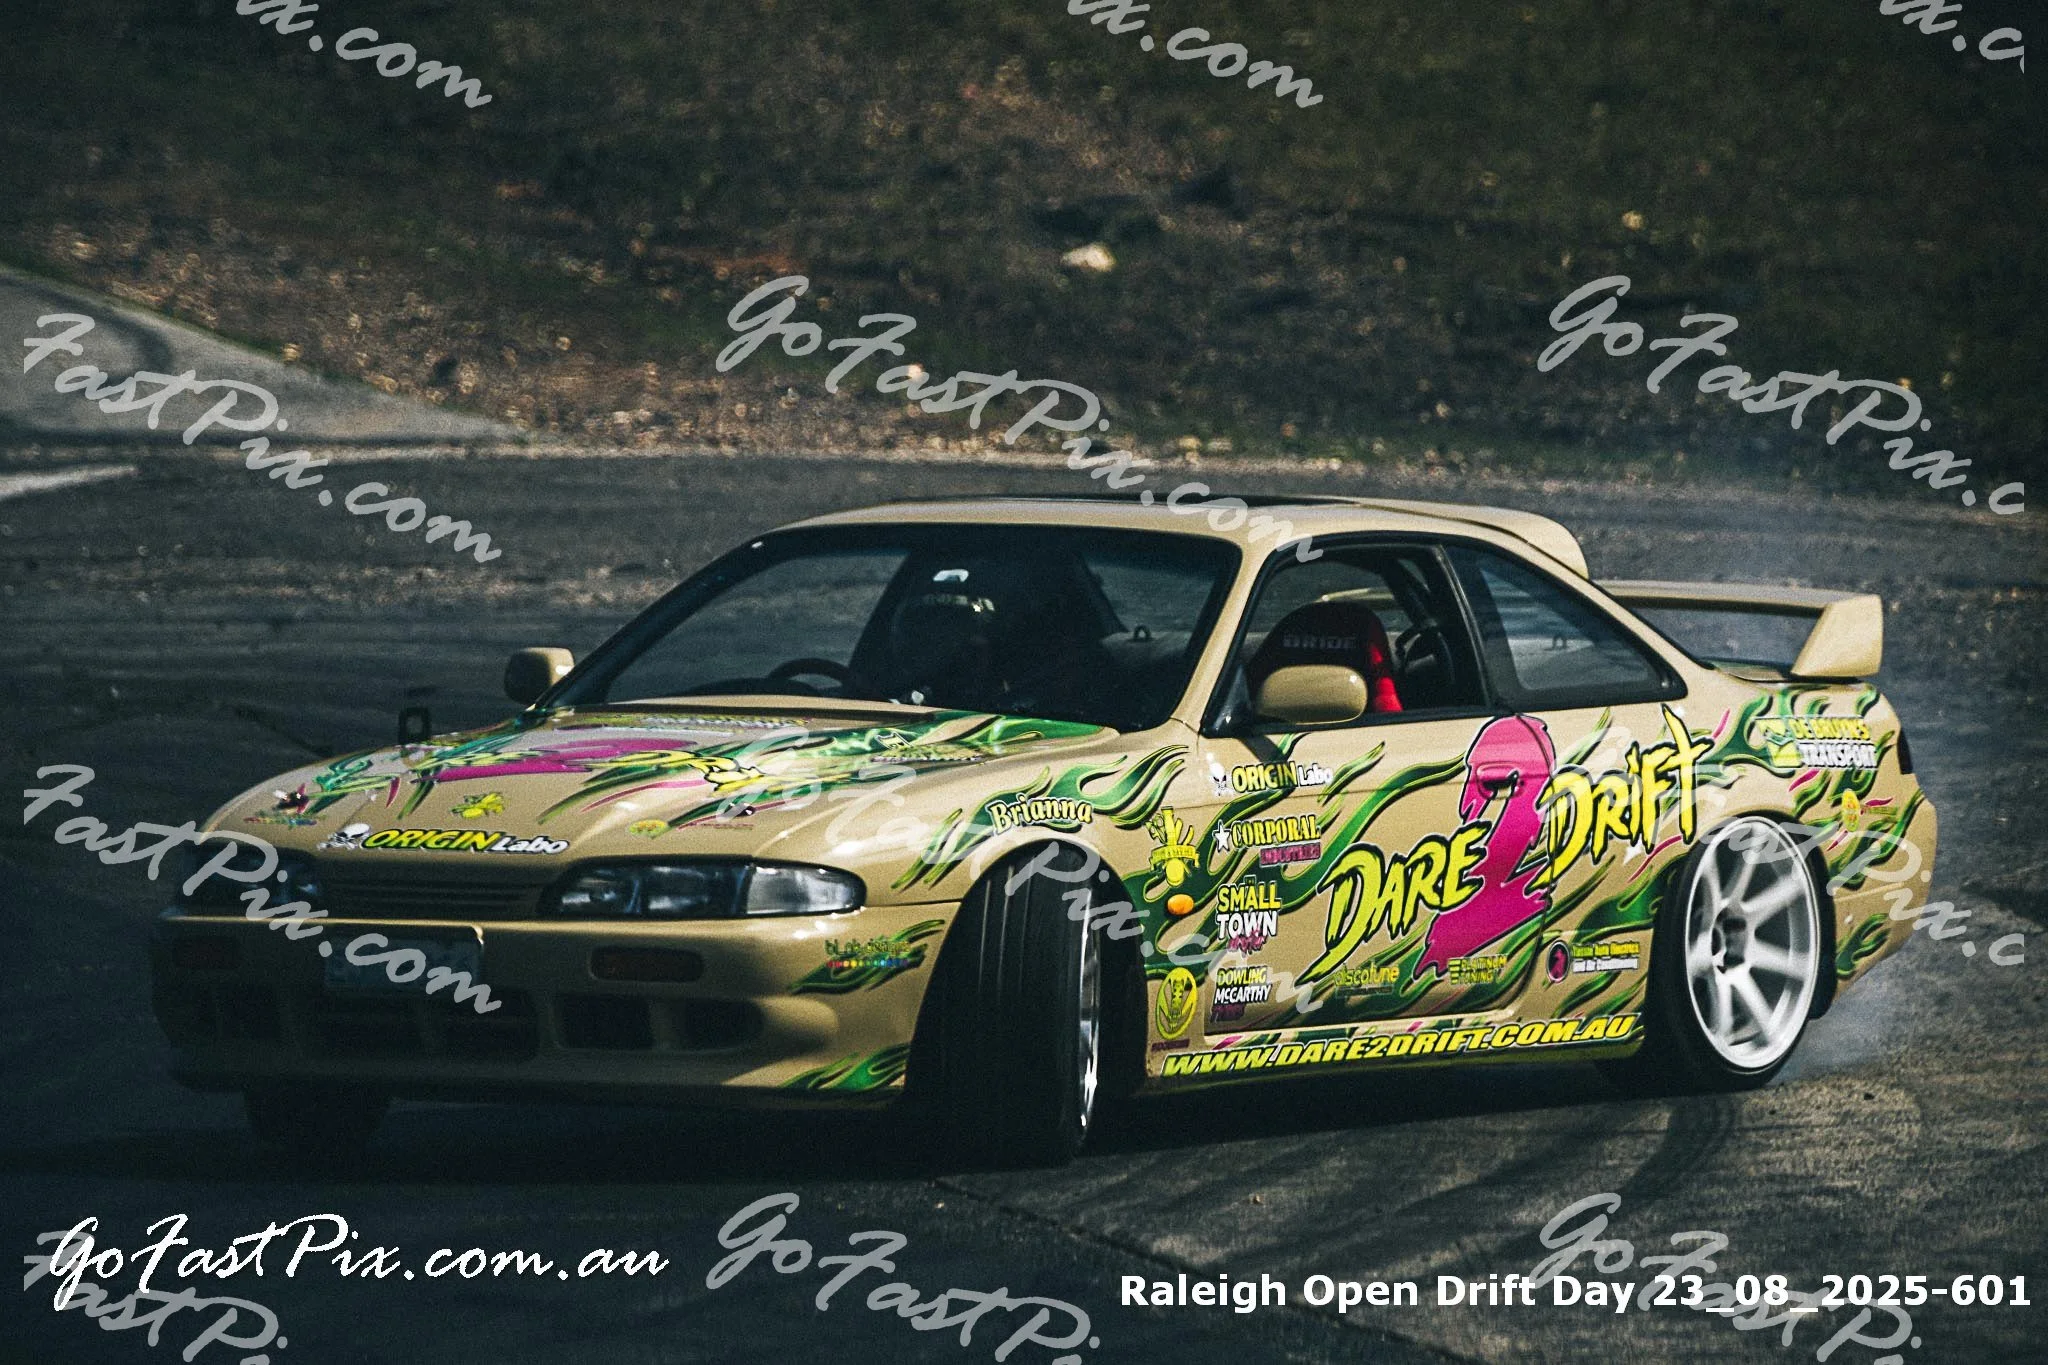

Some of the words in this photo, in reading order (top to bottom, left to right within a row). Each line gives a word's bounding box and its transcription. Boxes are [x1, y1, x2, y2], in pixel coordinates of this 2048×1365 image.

[1799, 743, 1878, 768] TRANSPORT
[1232, 761, 1297, 793] ORIGIN
[1298, 763, 1333, 786] Labo
[989, 794, 1093, 835] Brianna
[362, 828, 503, 850] ORIGIN
[491, 836, 570, 854] Labo
[1231, 815, 1321, 848] CORPORAL
[1295, 820, 1493, 986] DARE
[1413, 713, 1557, 981] 2
[1218, 881, 1282, 914] SMALL
[1216, 910, 1279, 940] TOWN
[1216, 966, 1268, 986] DOWLING
[1161, 1012, 1641, 1078] WWW.DARE2DRIFT.COM.AU
